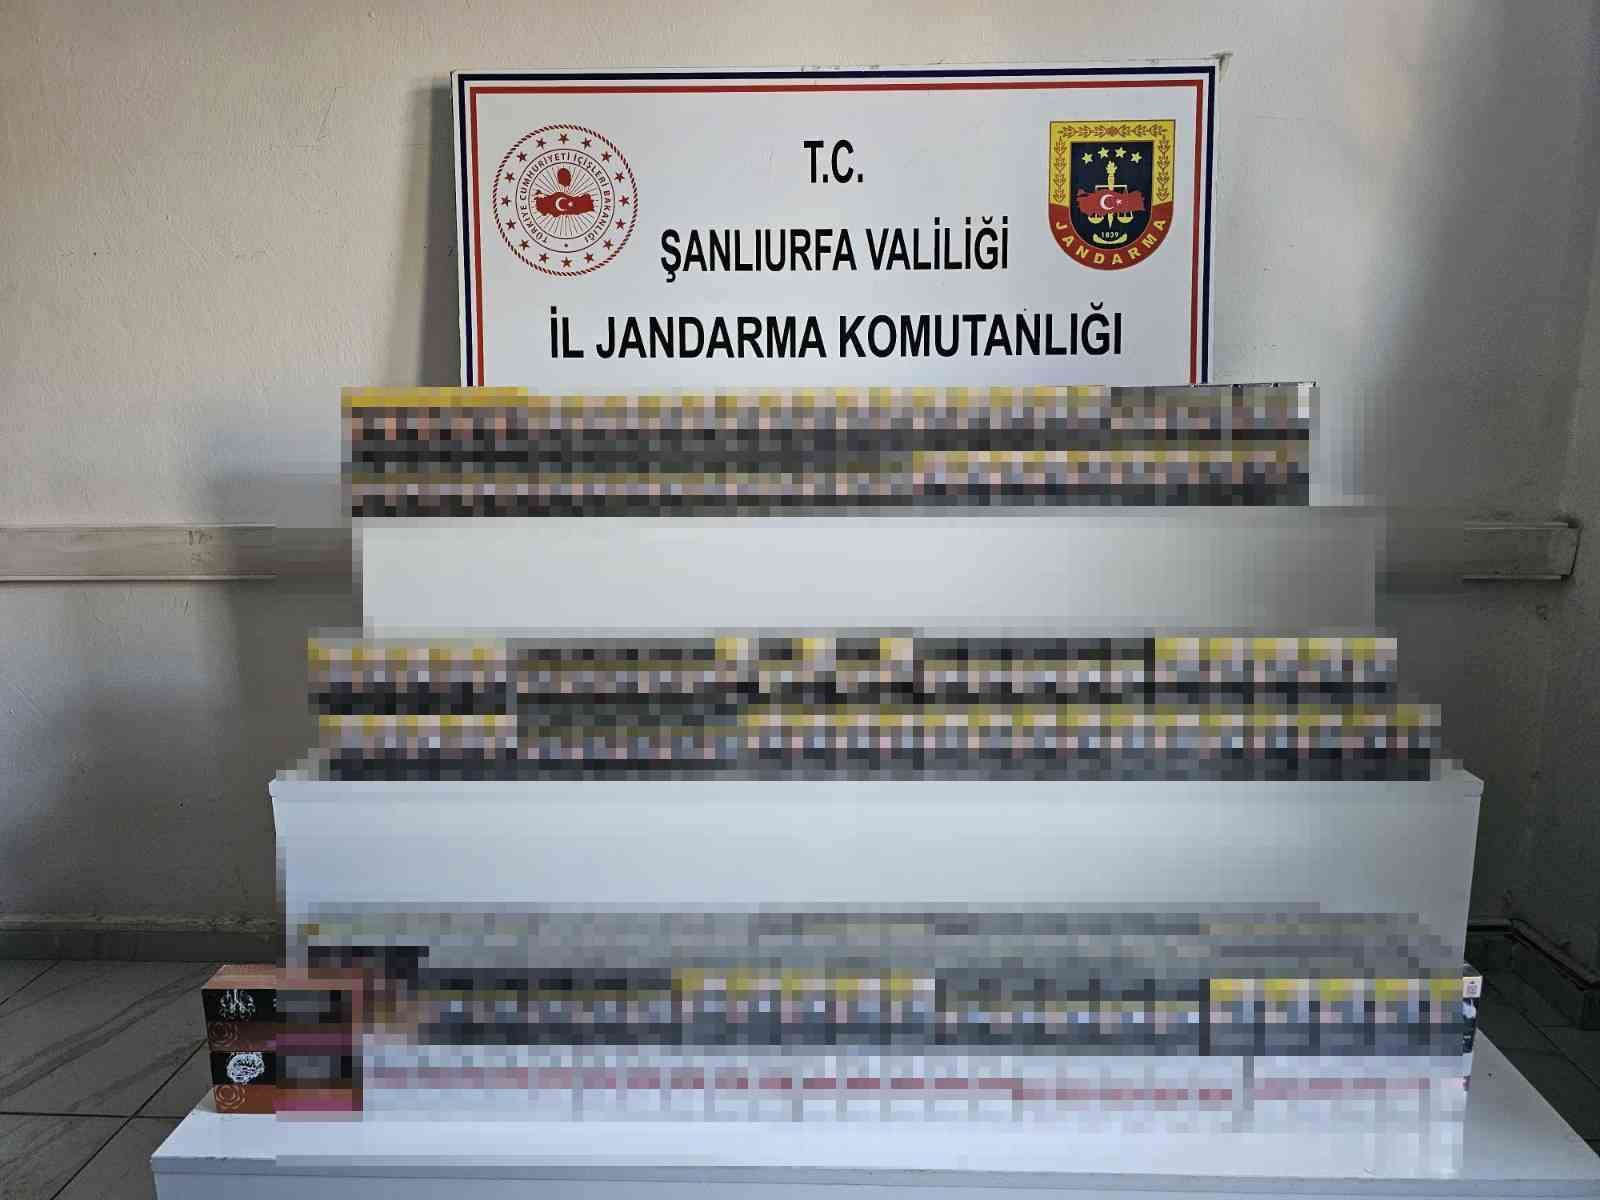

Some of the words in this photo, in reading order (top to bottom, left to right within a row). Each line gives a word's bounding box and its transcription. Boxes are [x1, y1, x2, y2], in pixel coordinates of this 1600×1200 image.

[519, 151, 571, 201] CUMHURİYETİ
[572, 152, 609, 189] İÇİŞLERİ
[804, 140, 863, 183] T.C.
[519, 206, 549, 244] TÜRKİYE
[584, 189, 612, 244] BAKANLIĞI
[661, 229, 856, 282] ŞANLIURFA
[866, 216, 1008, 270] VALİLİĞİ
[1056, 219, 1167, 265] JANDARMA
[551, 306, 584, 358] İL
[596, 317, 826, 358] JANDARMA
[840, 302, 1121, 357] KOMUTANLIĞI
